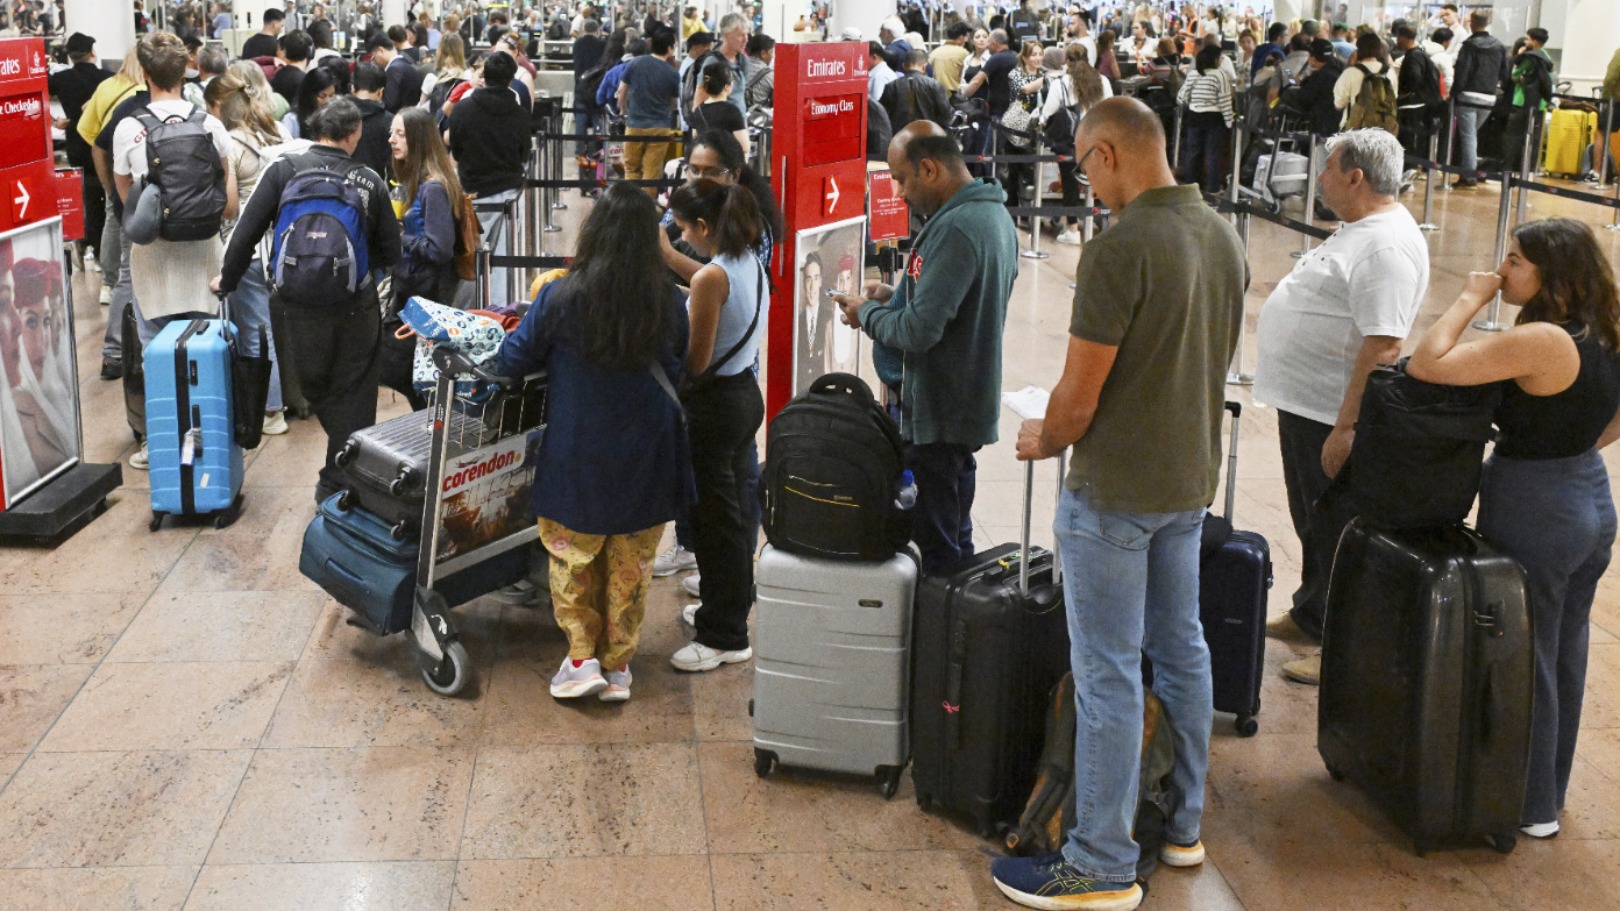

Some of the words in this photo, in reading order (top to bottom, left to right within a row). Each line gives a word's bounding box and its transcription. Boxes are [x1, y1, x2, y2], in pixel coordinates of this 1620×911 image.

[0, 57, 20, 75] ates
[807, 58, 845, 77] Emirates
[811, 102, 839, 116] Economy
[839, 99, 854, 112] Class
[442, 450, 516, 492] corendon
